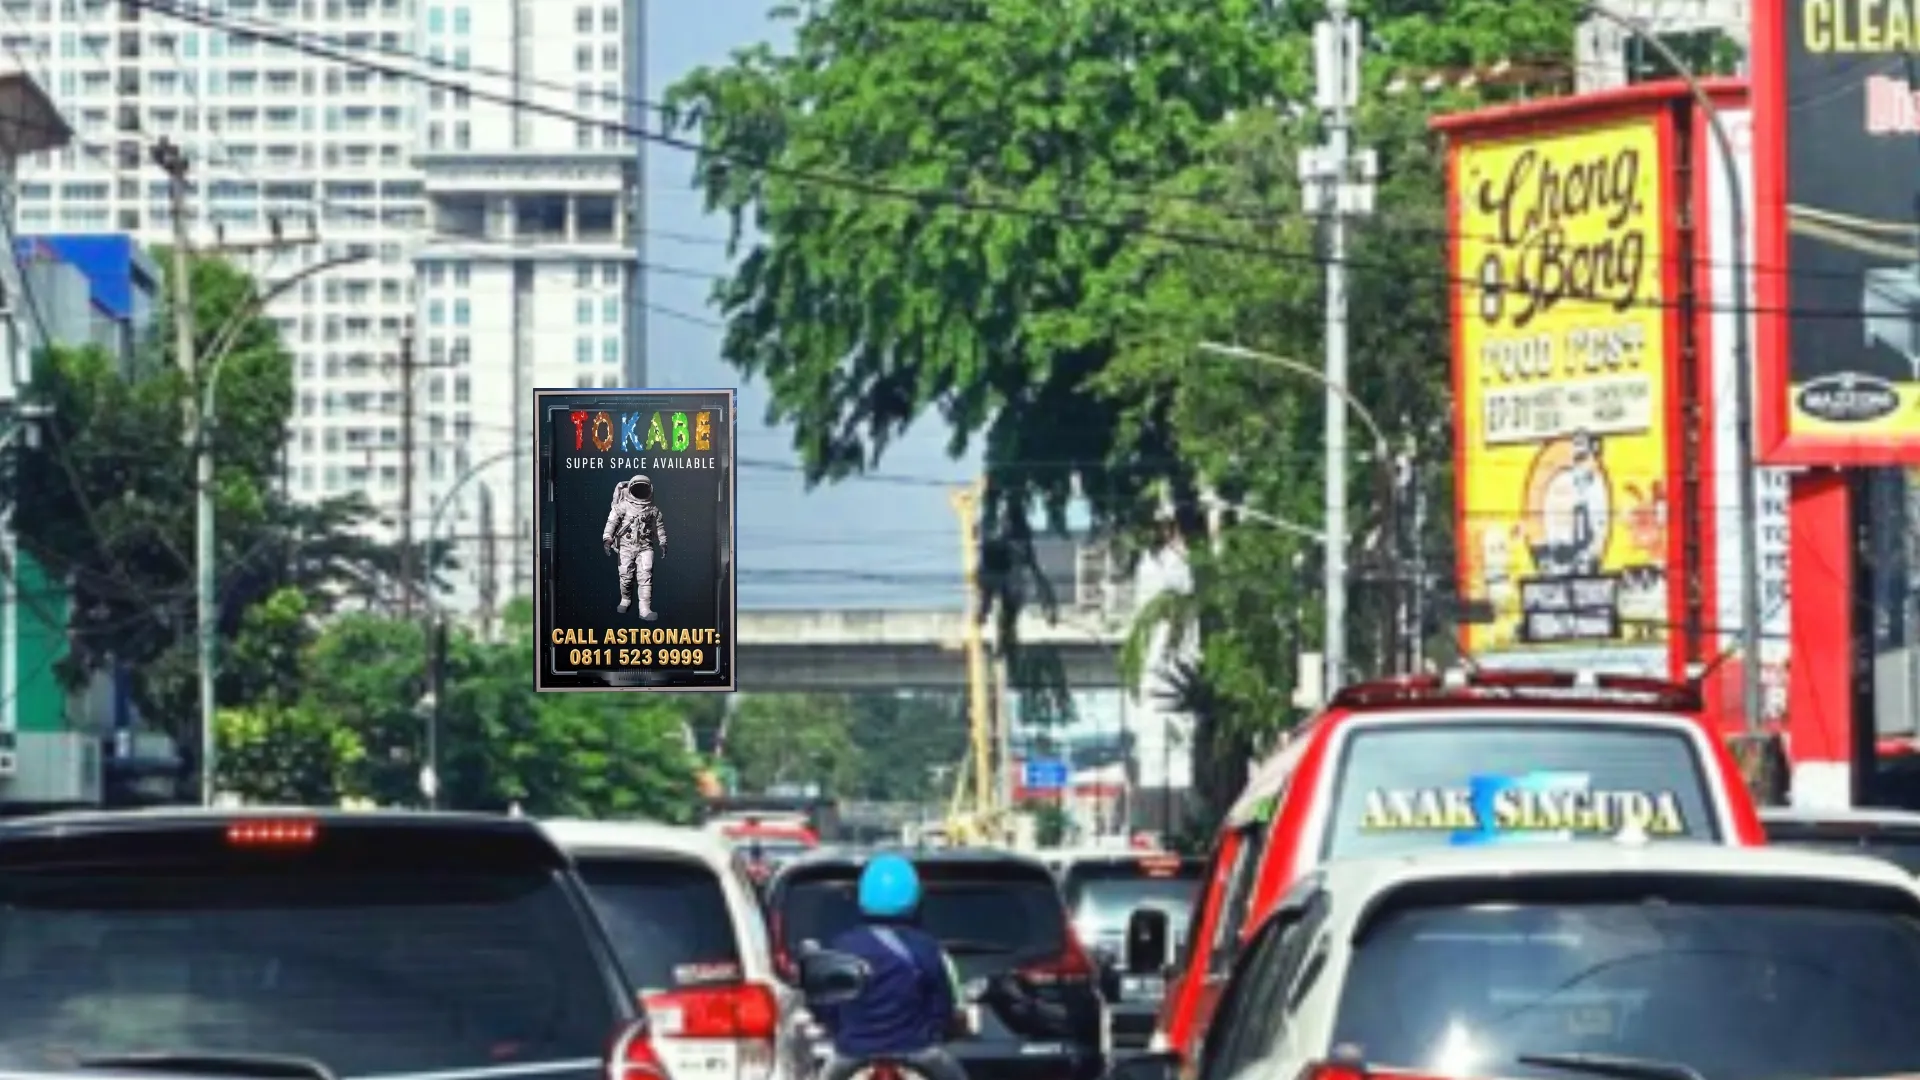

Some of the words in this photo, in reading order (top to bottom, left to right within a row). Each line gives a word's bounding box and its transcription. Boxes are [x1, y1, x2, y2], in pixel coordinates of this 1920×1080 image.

[1803, 0, 1920, 53] CLEA
[570, 410, 712, 452] TOKABE
[566, 457, 604, 470] SUPER
[610, 457, 648, 470] SPACE
[652, 457, 716, 470] AVAILABLE
[551, 628, 598, 645] CALL
[604, 628, 721, 645] ASTRONAUT:
[569, 648, 611, 666] 0811
[618, 648, 652, 666] 523
[658, 648, 704, 666] 9999
[1362, 787, 1475, 829] ANAK
